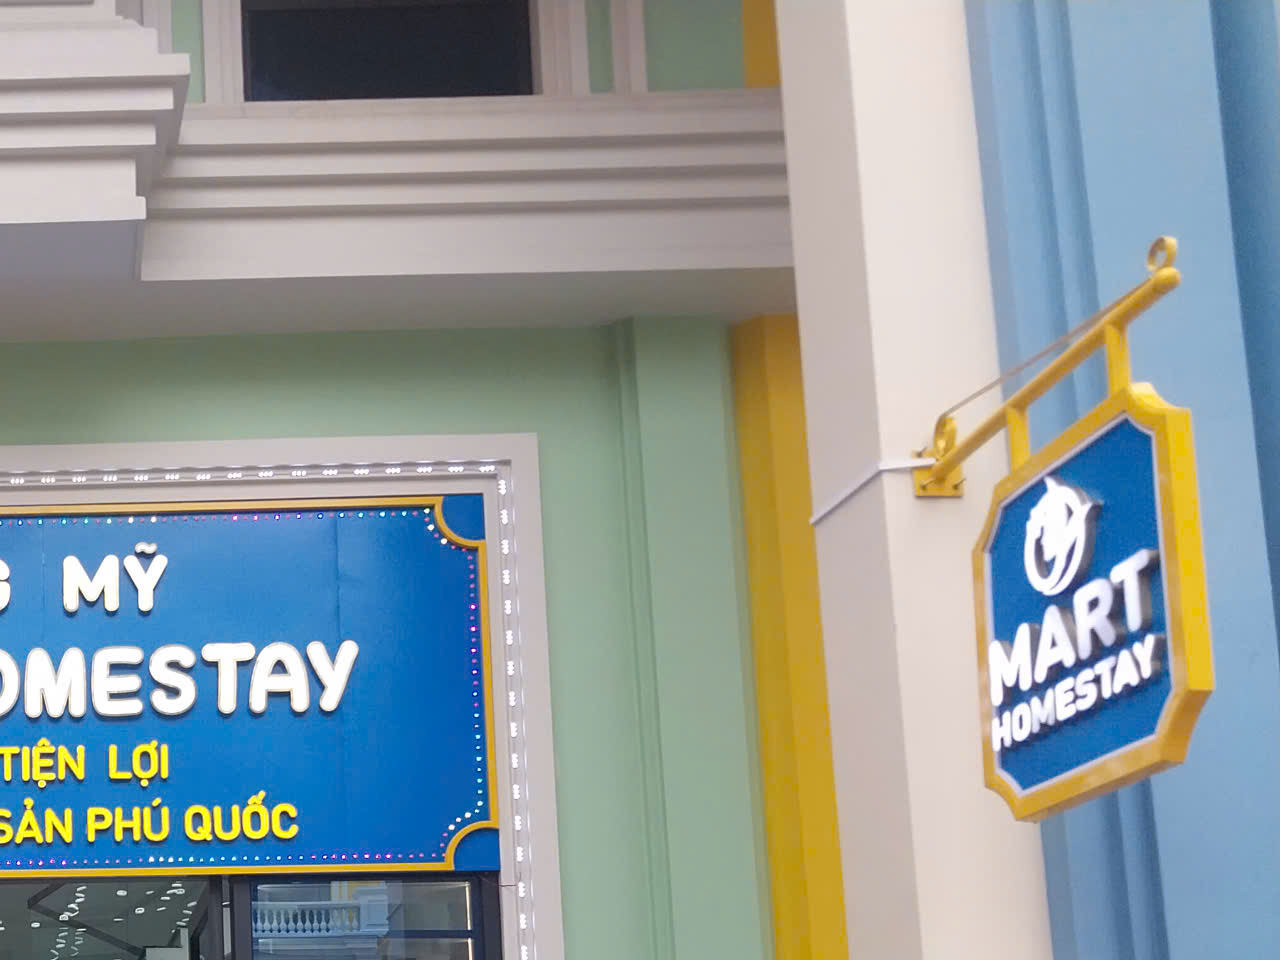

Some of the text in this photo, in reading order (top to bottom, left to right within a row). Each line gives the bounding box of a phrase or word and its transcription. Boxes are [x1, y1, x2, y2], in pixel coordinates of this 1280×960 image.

[62, 542, 168, 613] MỸ
[988, 549, 1156, 707] MART
[992, 634, 1157, 752] HOMESTAY
[108, 740, 169, 788] LỢI
[87, 797, 170, 843] PHÚ
[184, 790, 300, 842] QUỐC
